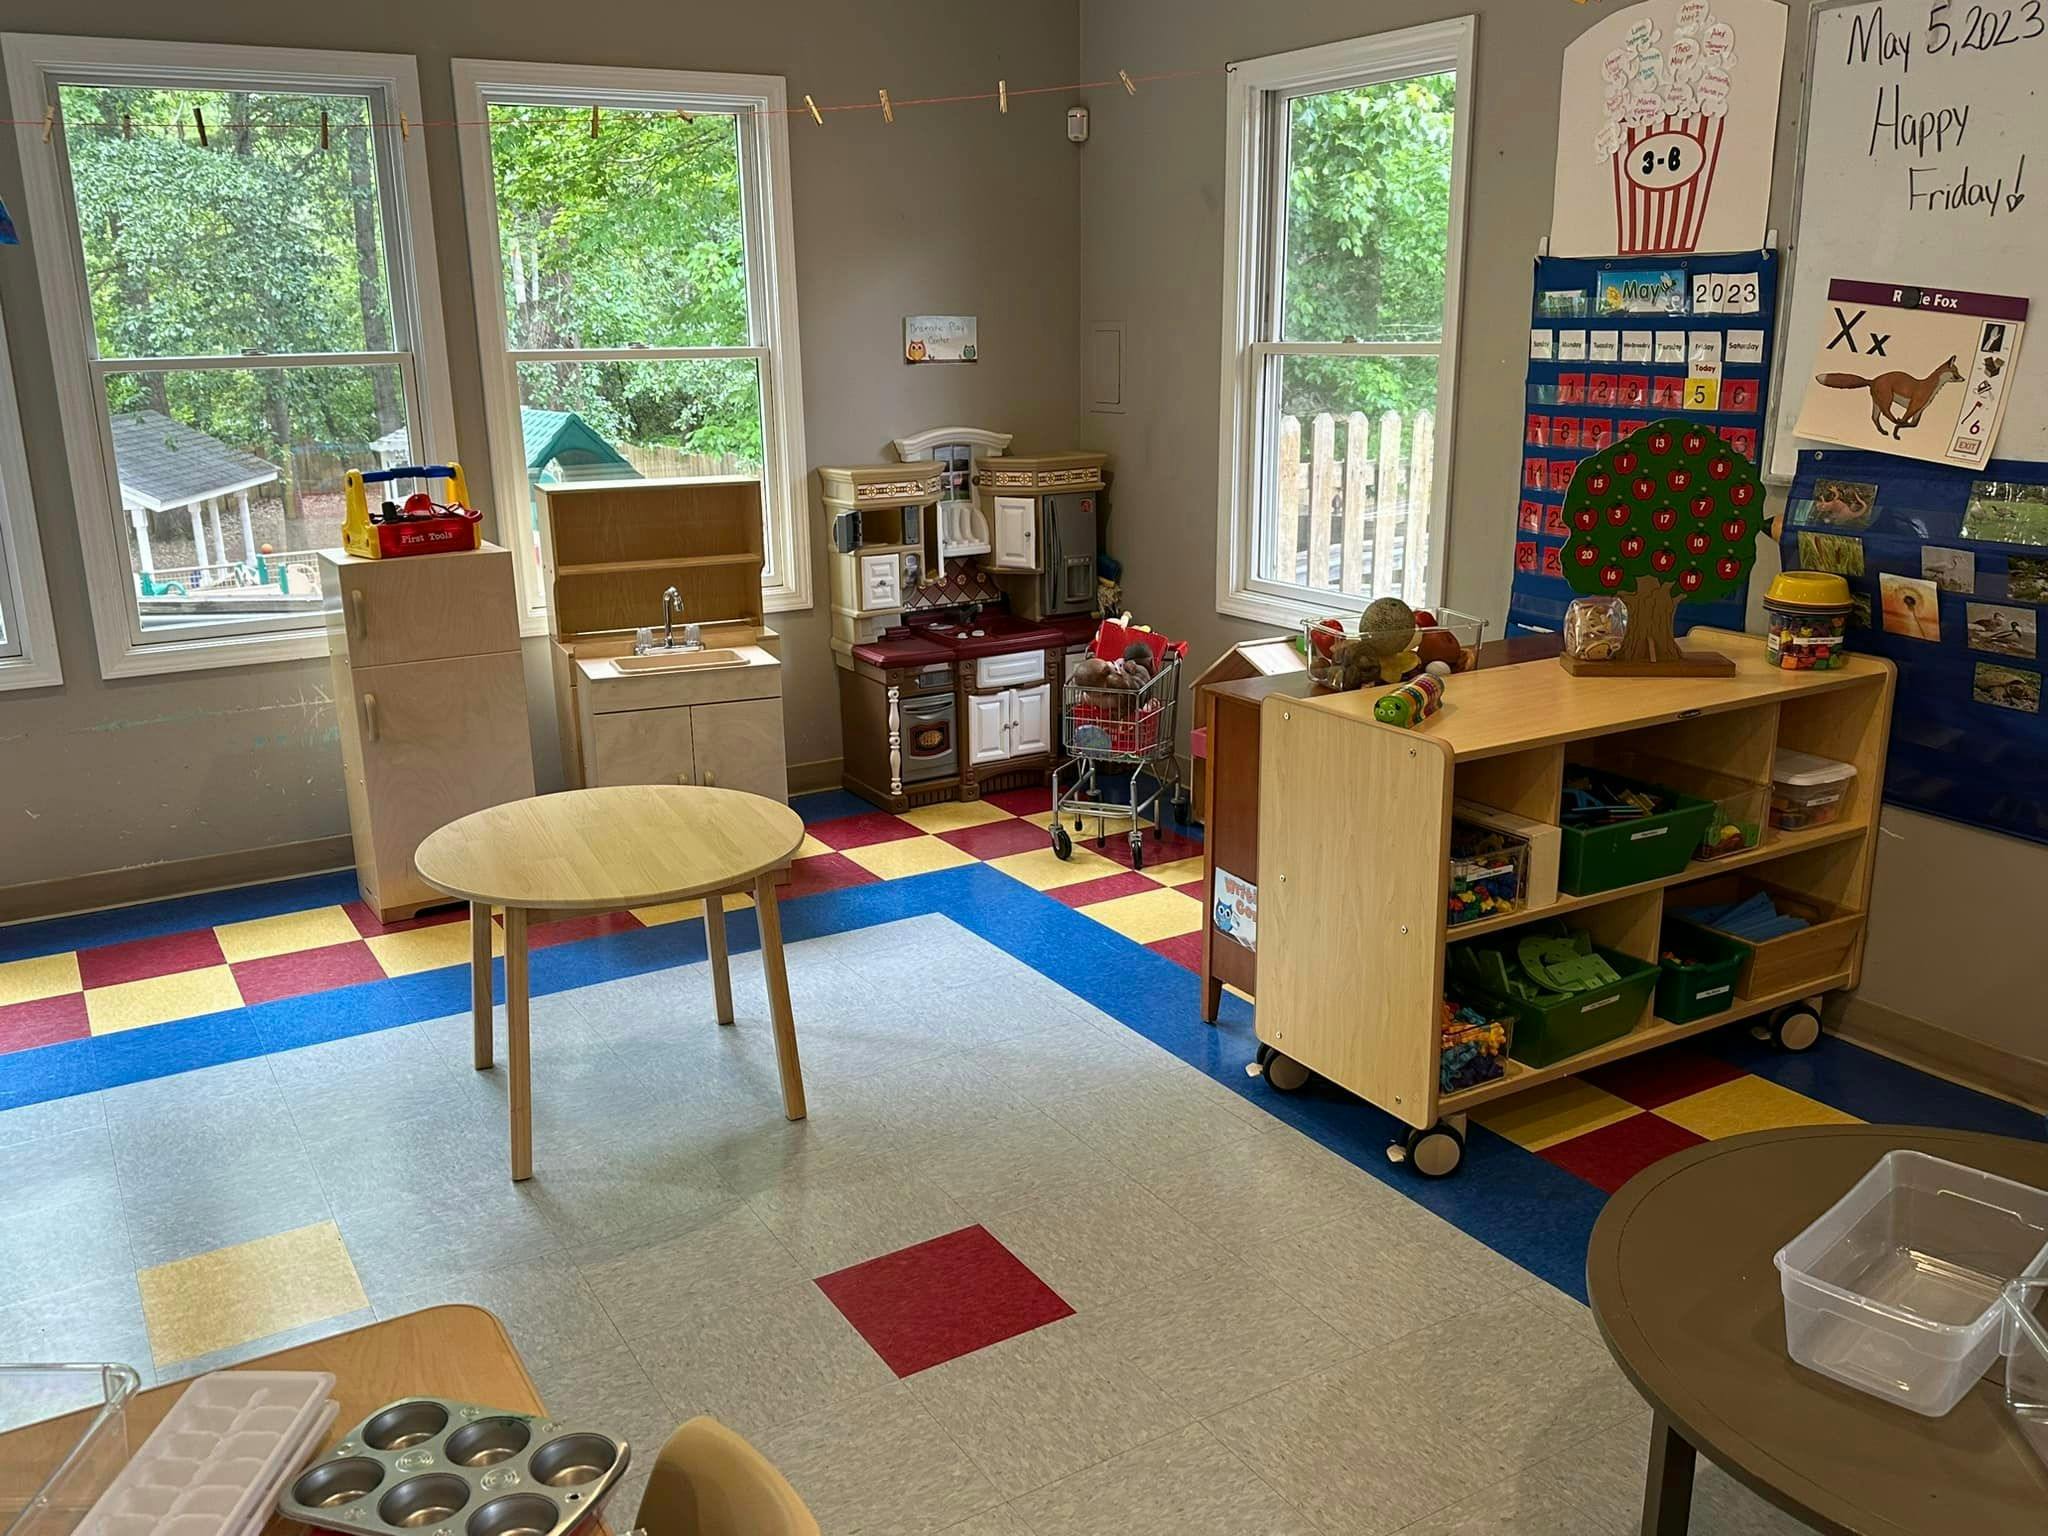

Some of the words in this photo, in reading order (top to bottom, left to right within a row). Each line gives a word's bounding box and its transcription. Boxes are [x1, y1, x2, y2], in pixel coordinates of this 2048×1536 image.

[1847, 6, 1911, 73] May
[1672, 43, 1691, 54] Theo
[1869, 84, 1969, 158] Happy
[1622, 280, 1660, 305] May
[1696, 283, 1756, 303] 2023
[1892, 289, 1931, 306] Rie
[1933, 293, 1959, 308] Fox
[1657, 343, 1682, 352] Tursday
[1695, 364, 1716, 374] Today
[1568, 380, 1575, 397] 1
[1599, 381, 1608, 398] 2
[1628, 382, 1639, 400] 3
[1662, 384, 1673, 400] 4
[1694, 386, 1705, 403] 5
[1733, 386, 1745, 404] 6
[1561, 423, 1570, 440] 8
[1969, 420, 1981, 435] 6
[1592, 425, 1602, 442] 9
[1655, 439, 1665, 448] 13
[1690, 439, 1699, 448] 14
[1959, 441, 1977, 451] EXIT
[1717, 463, 1723, 472] 8
[1675, 475, 1685, 484] 12
[1594, 481, 1604, 489] 15
[1640, 483, 1647, 493] 4
[1738, 489, 1745, 498] 5
[1700, 502, 1706, 510] 7
[1583, 514, 1589, 523] 9
[1615, 510, 1621, 519] 3
[1660, 514, 1670, 523] 17
[1730, 525, 1738, 534] 11
[402, 535, 425, 543] First
[429, 531, 453, 541] Tools
[1628, 541, 1638, 551] 19
[1694, 538, 1703, 547] 10
[1520, 547, 1533, 563] 28
[1582, 550, 1593, 559] 20
[1660, 555, 1667, 565] 6
[1725, 563, 1732, 572] 2
[1607, 571, 1616, 580] 16
[1687, 575, 1696, 584] 18
